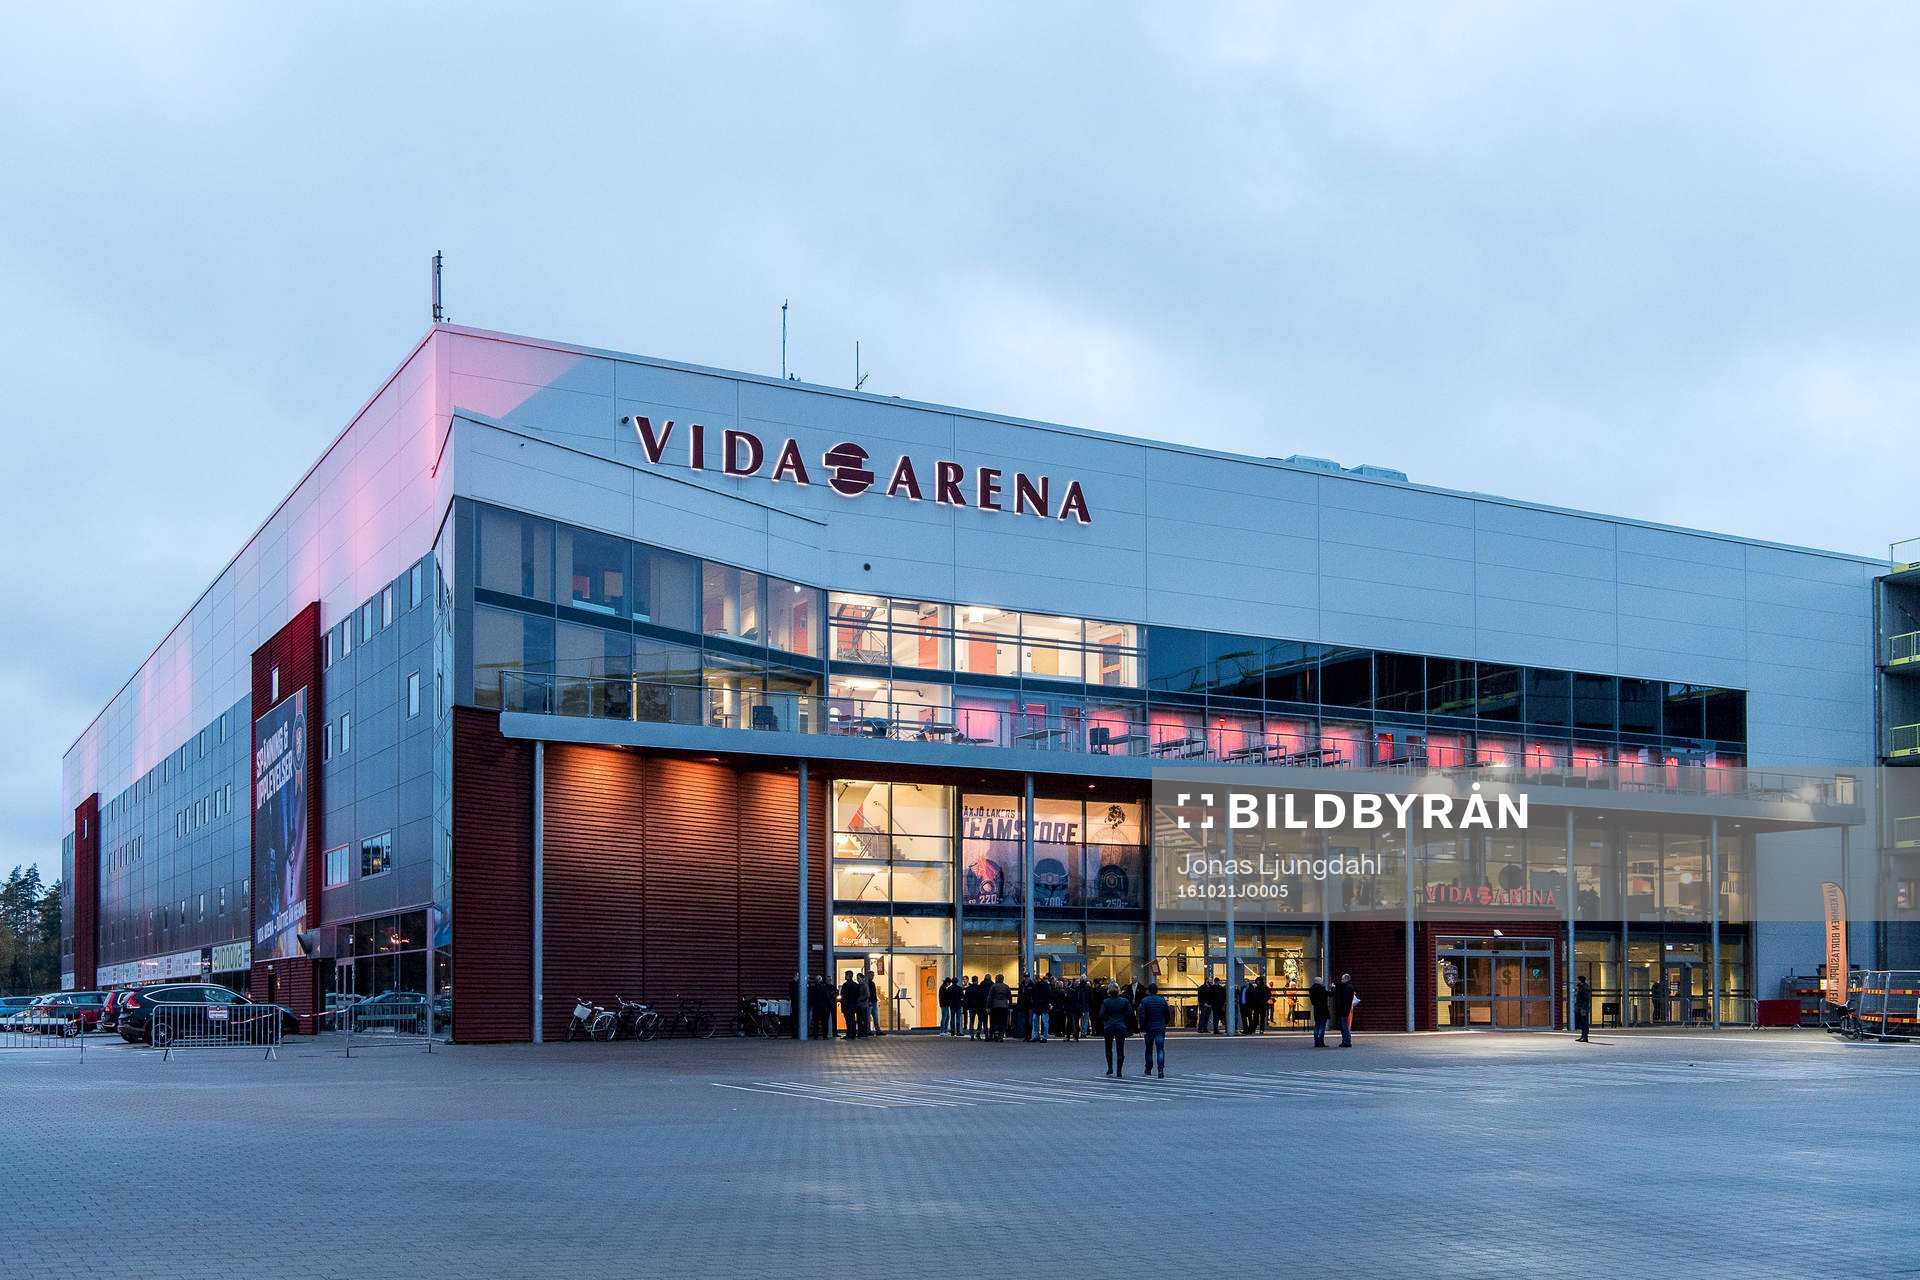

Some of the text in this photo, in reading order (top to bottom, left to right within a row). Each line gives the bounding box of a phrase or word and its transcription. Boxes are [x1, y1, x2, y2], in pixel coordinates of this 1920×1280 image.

[633, 415, 1092, 524] VIDA ARENA
[256, 749, 293, 810] UPPLEVELSER
[963, 806, 984, 817] ÄXJÖ
[1425, 883, 1557, 905] VIDA ARENA
[213, 944, 243, 971] avonova
